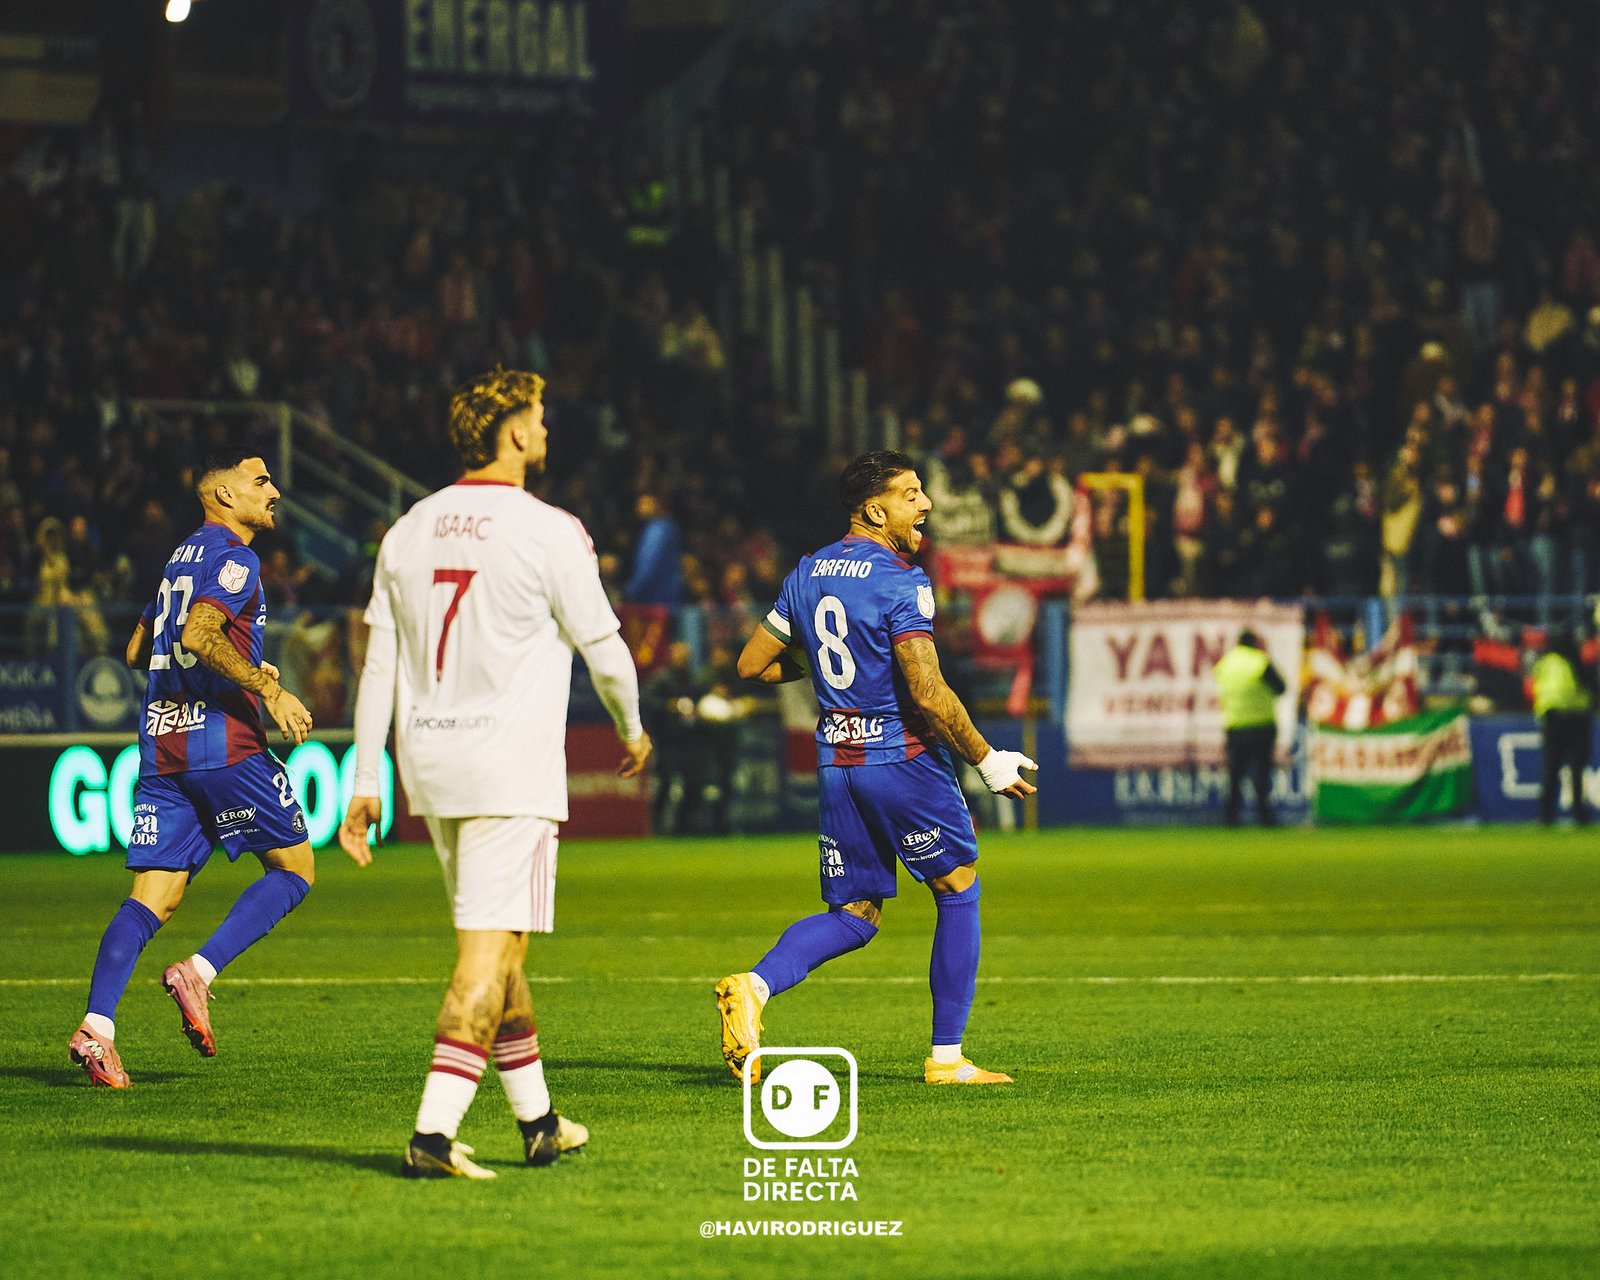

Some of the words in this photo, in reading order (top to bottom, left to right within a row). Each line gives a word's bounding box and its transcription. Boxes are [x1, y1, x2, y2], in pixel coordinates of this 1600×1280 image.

[434, 514, 492, 541] ISAAC
[811, 558, 873, 579] ZARFINO
[149, 575, 198, 671] 23
[433, 568, 477, 684] 7
[814, 595, 856, 690] 8
[177, 700, 206, 727] 3LC
[849, 716, 885, 740] 3LC
[272, 772, 295, 808] 2
[134, 803, 159, 814] RWAY
